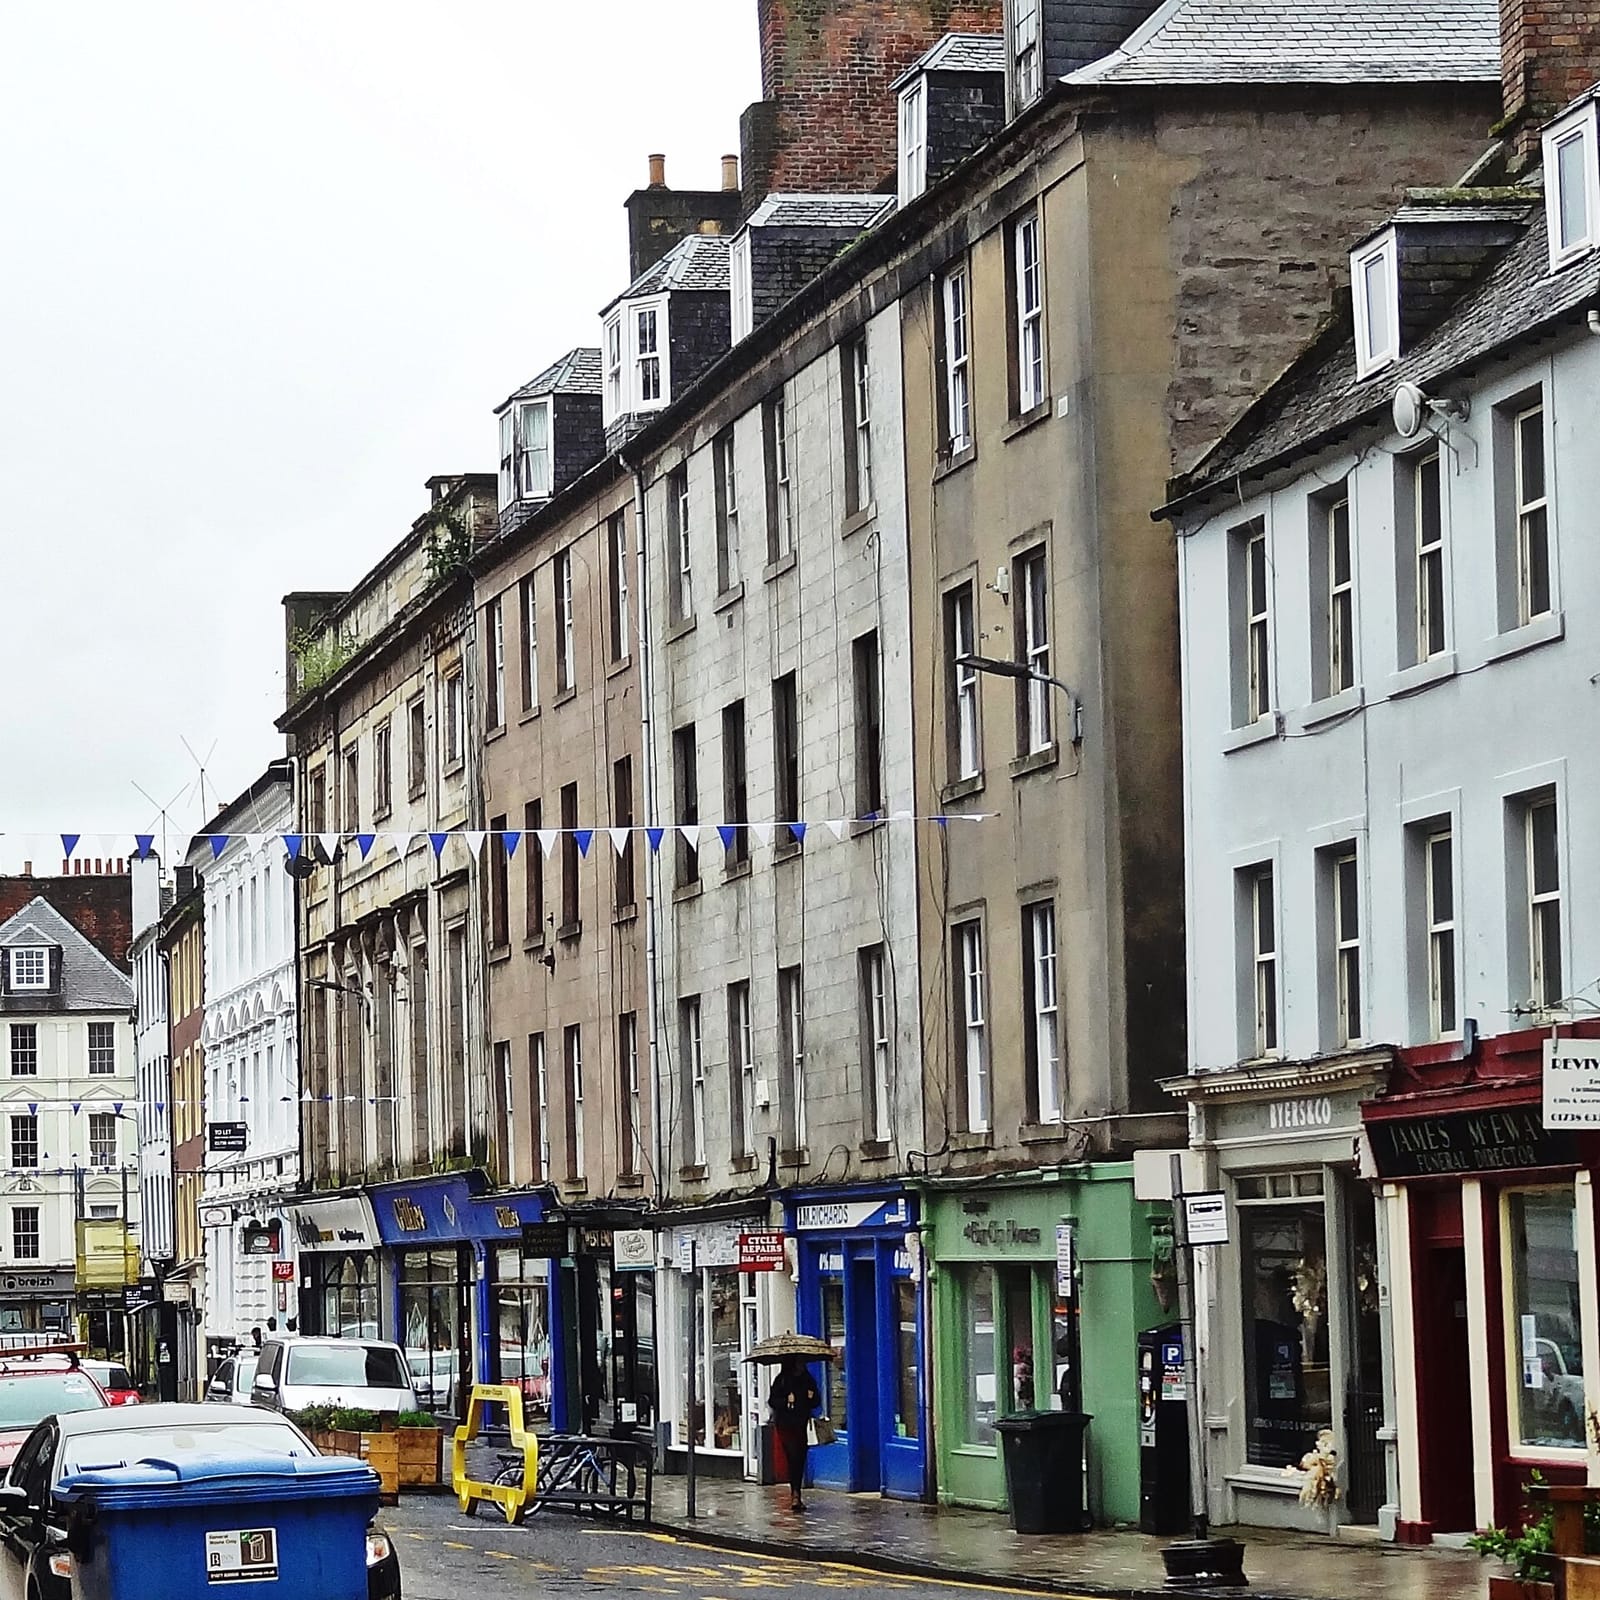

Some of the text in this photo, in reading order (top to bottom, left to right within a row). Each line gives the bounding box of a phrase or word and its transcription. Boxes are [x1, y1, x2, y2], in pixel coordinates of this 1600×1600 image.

[1388, 1120, 1451, 1158] JAMES
[1416, 1145, 1537, 1173] FUNERAL DIRECTOR
[747, 1236, 778, 1245] CYCLE
[742, 1245, 783, 1254] REPAIRS
[741, 1255, 755, 1263] Side
[17, 1276, 55, 1287] breizh
[1167, 1347, 1179, 1361] P
